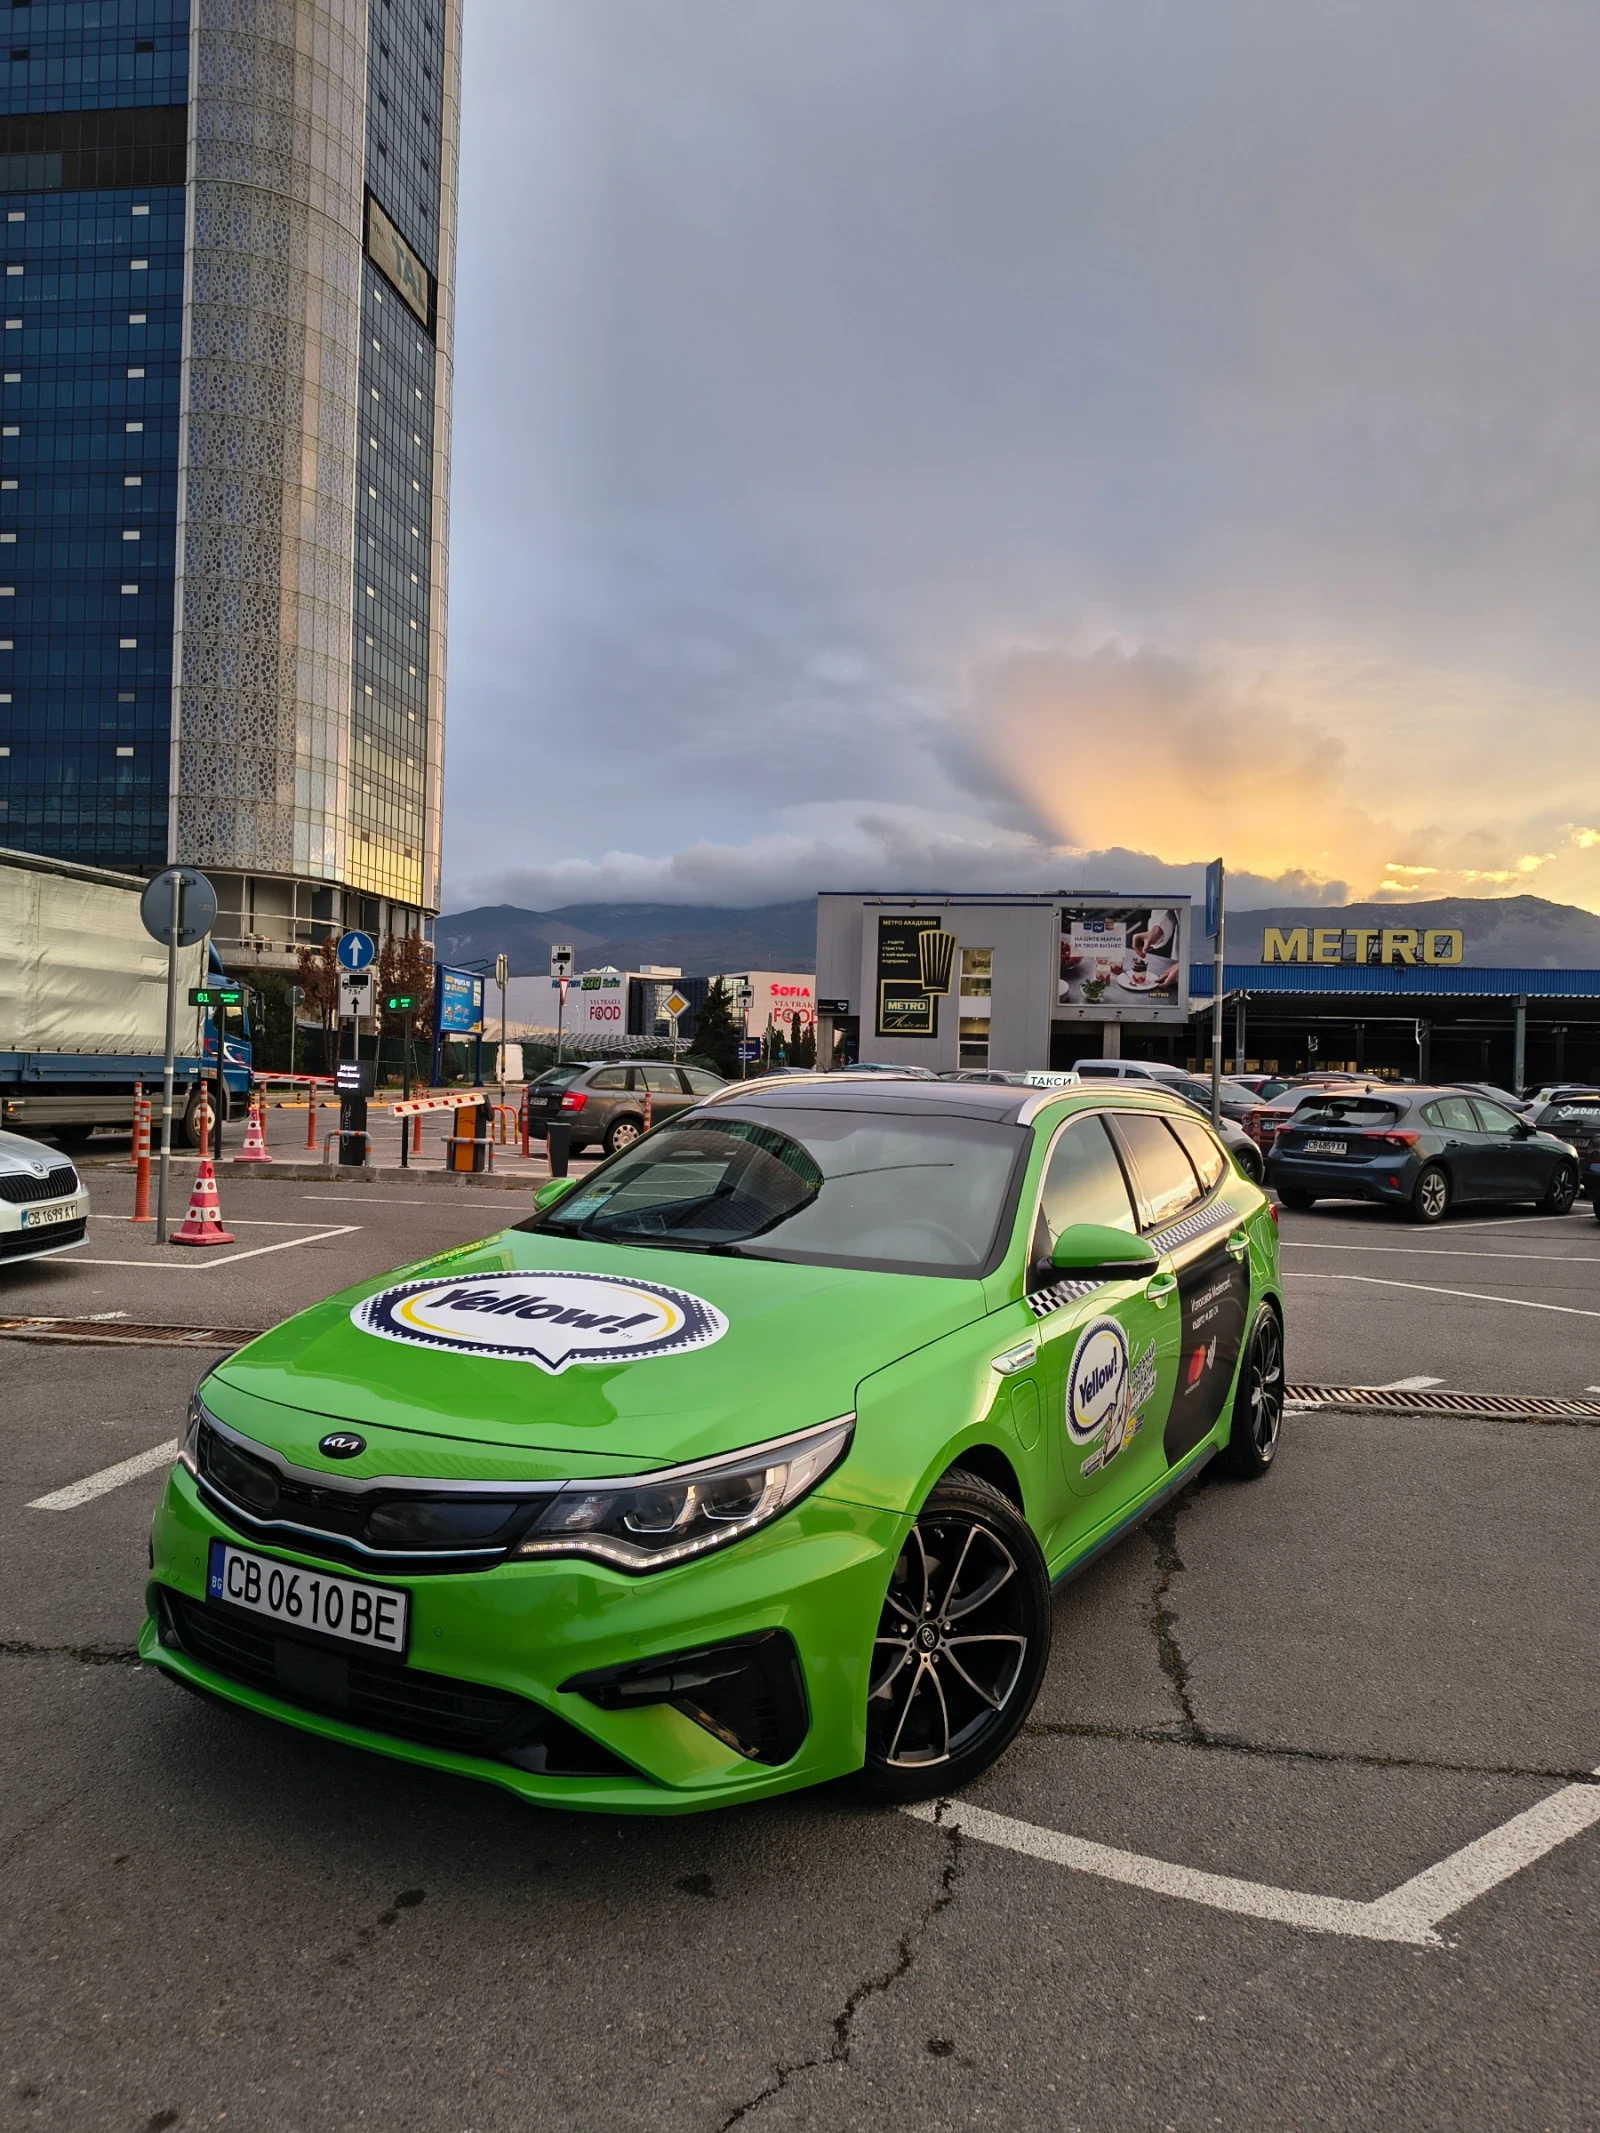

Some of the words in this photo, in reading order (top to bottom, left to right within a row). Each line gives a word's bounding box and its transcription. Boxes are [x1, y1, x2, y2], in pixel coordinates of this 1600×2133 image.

[1263, 927, 1464, 965] METRO
[197, 992, 210, 1003] 61
[770, 983, 811, 997] SOFIA
[774, 1000, 790, 1008] VIA
[887, 1001, 926, 1011] METRO
[589, 1006, 621, 1021] FOOD
[883, 1014, 929, 1028] Академия
[1030, 1076, 1072, 1087] ТАКСИ
[28, 1211, 41, 1226] CB
[43, 1208, 63, 1223] 1699
[424, 1288, 659, 1334] Yellow!
[1078, 1346, 1118, 1409] Yellow!
[211, 1575, 223, 1590] BG
[228, 1556, 262, 1604] CB
[268, 1569, 344, 1629] 0610
[350, 1589, 398, 1644] BE
